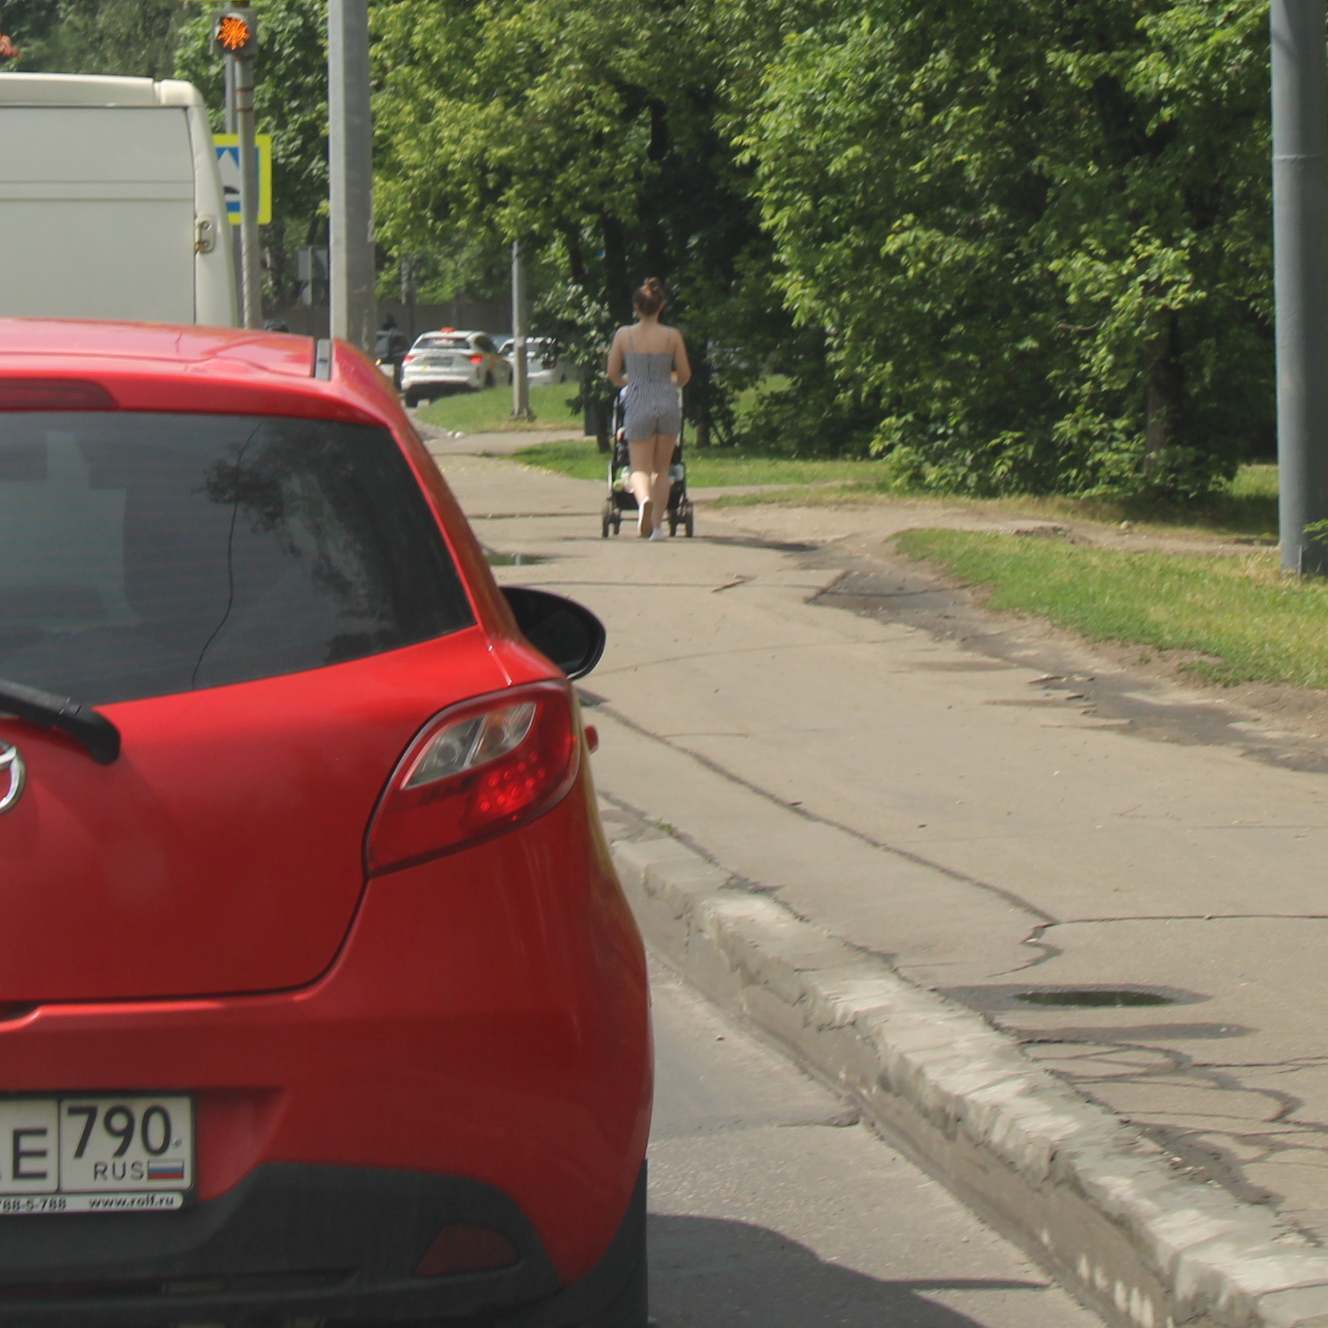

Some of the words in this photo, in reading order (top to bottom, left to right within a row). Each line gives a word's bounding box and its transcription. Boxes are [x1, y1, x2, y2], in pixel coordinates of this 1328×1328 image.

[66, 1104, 173, 1159] 790
[93, 1160, 144, 1182] RUS
[88, 1192, 175, 1209] www.rolf.ru
